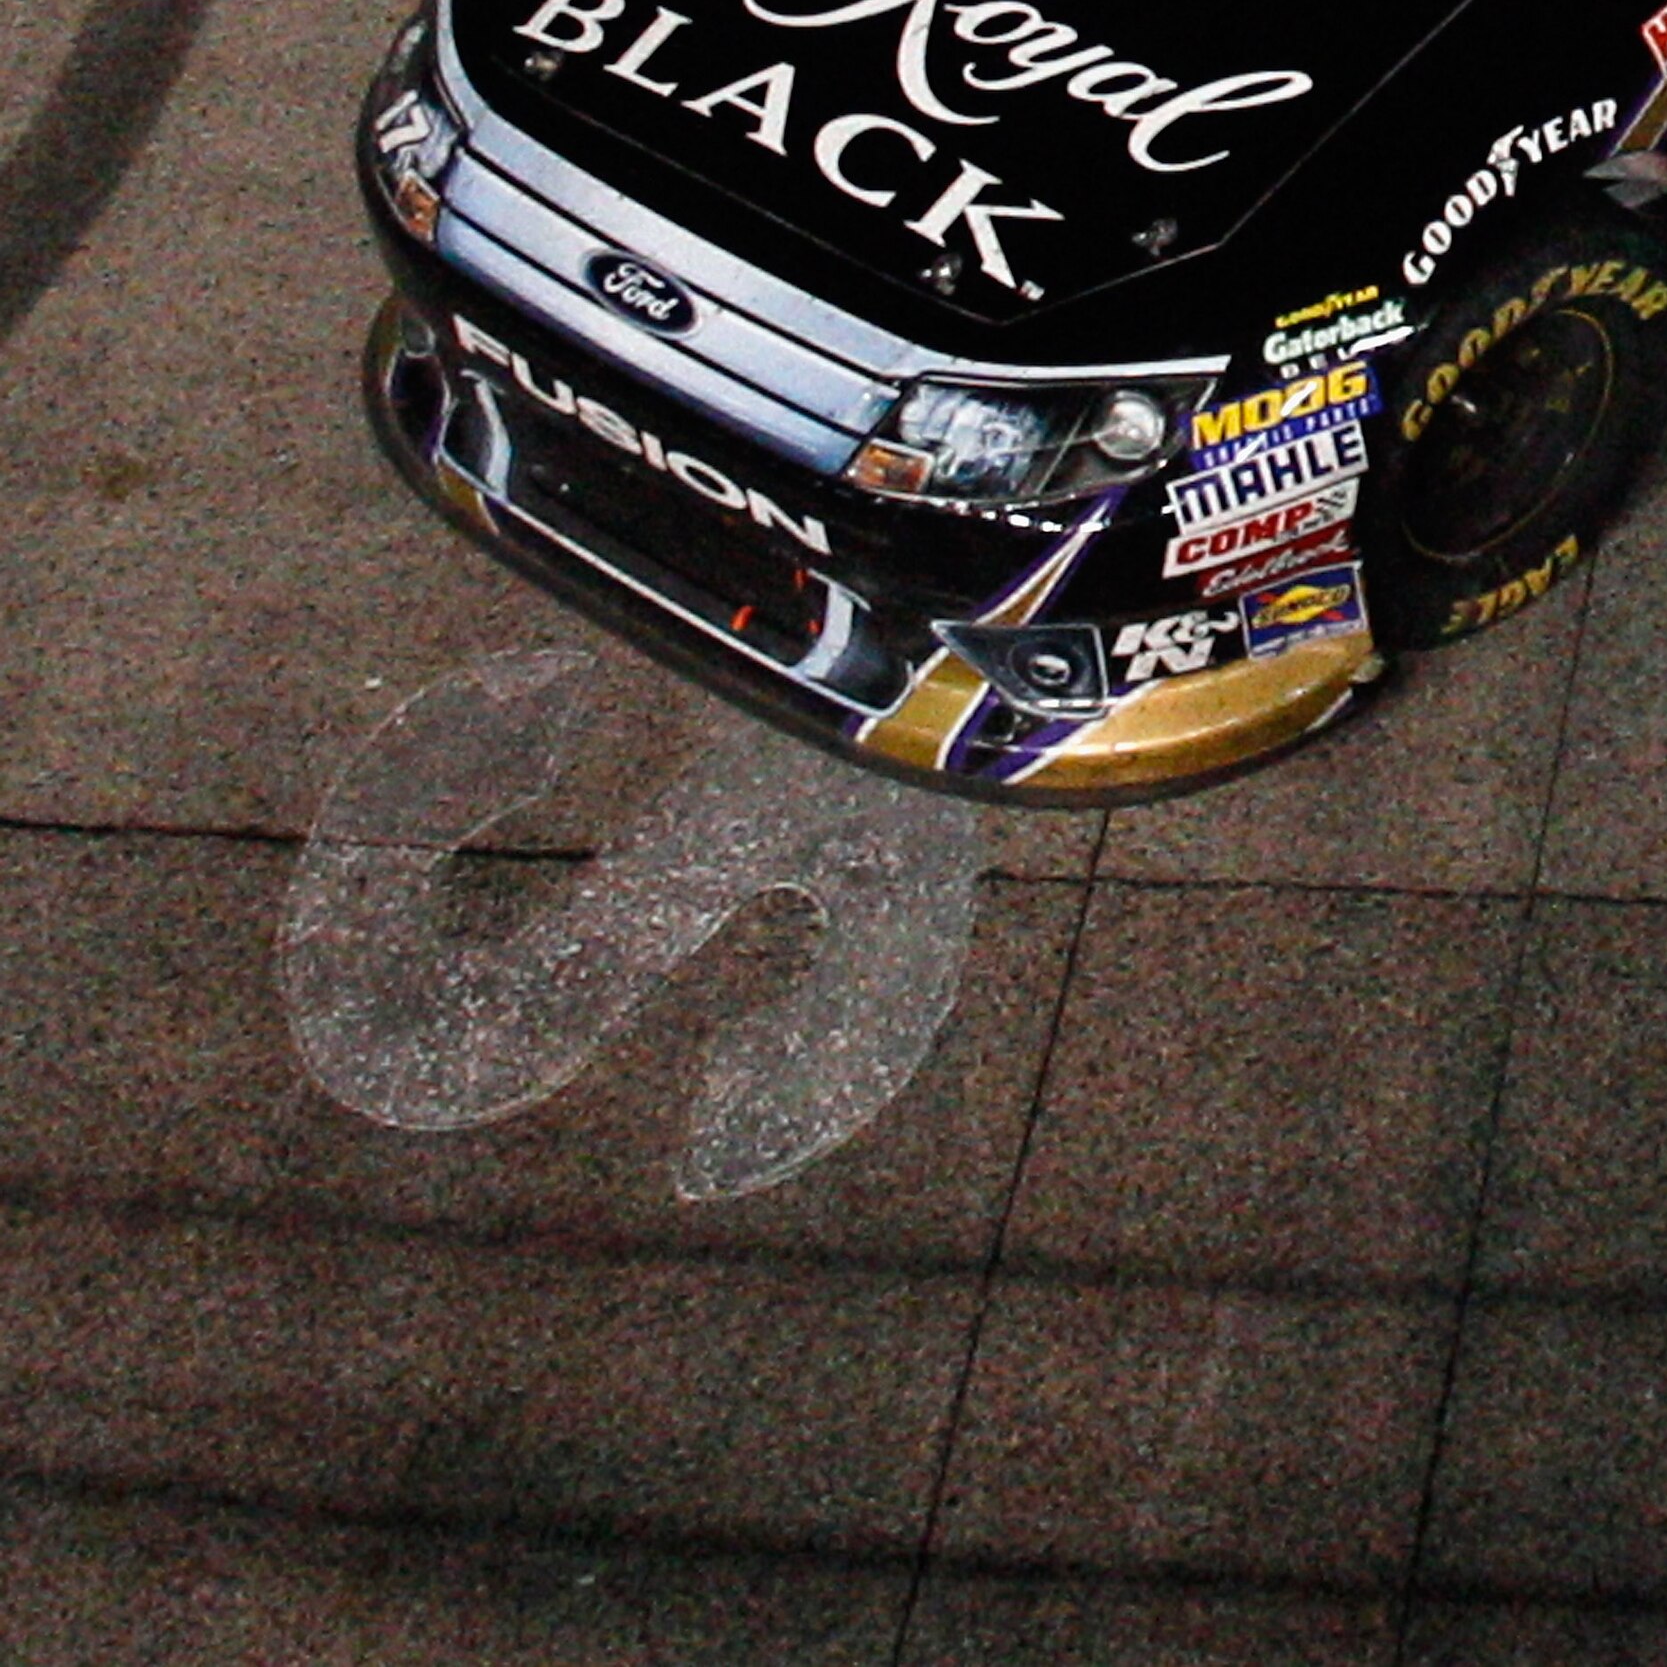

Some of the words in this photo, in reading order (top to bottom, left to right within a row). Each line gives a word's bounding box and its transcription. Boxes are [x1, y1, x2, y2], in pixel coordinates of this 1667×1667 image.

[1402, 98, 1618, 286] GOODYEAR
[602, 261, 679, 321] Ford
[1262, 299, 1404, 365] Gatorback
[452, 312, 832, 557] FUSION
[1192, 360, 1368, 450] MOOG
[1176, 431, 1361, 526] MAHLE
[1176, 501, 1316, 566] COMP
